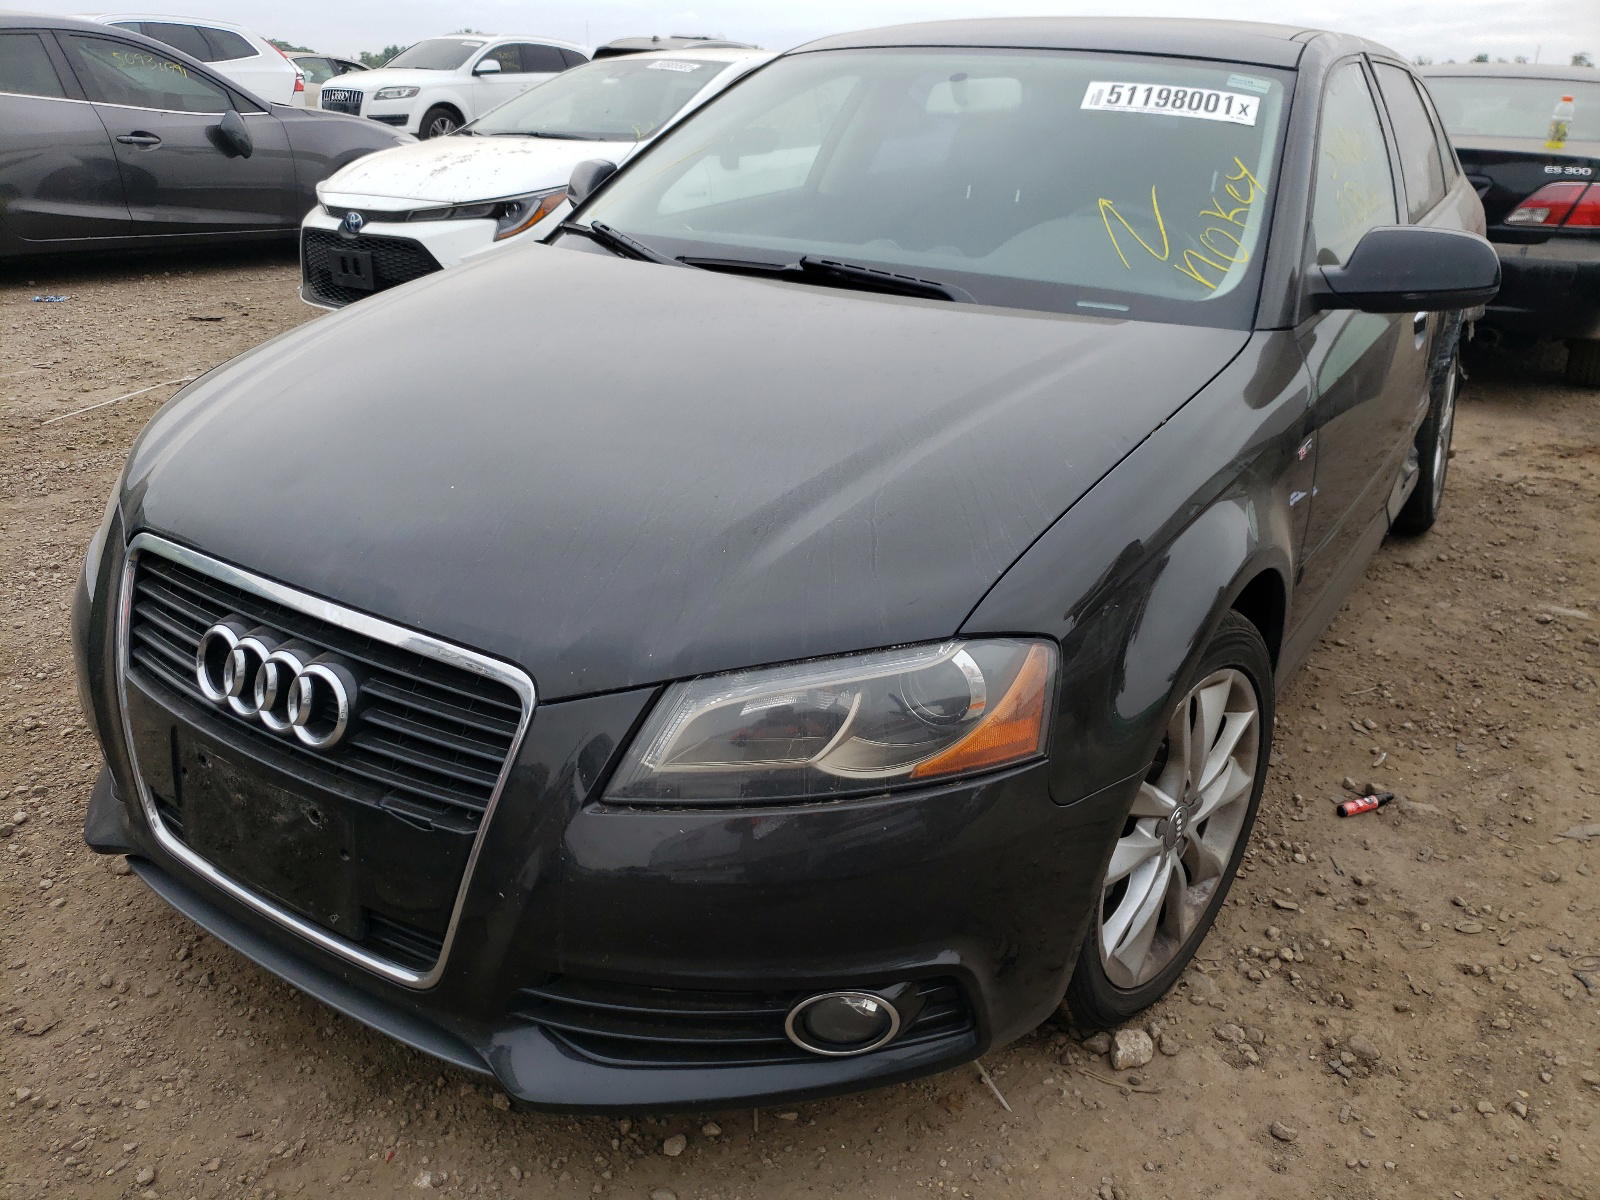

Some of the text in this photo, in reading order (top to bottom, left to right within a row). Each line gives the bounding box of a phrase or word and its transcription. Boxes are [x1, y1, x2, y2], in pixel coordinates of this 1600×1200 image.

[1106, 84, 1235, 115] 51198001
[1544, 165, 1593, 176] ES 300
